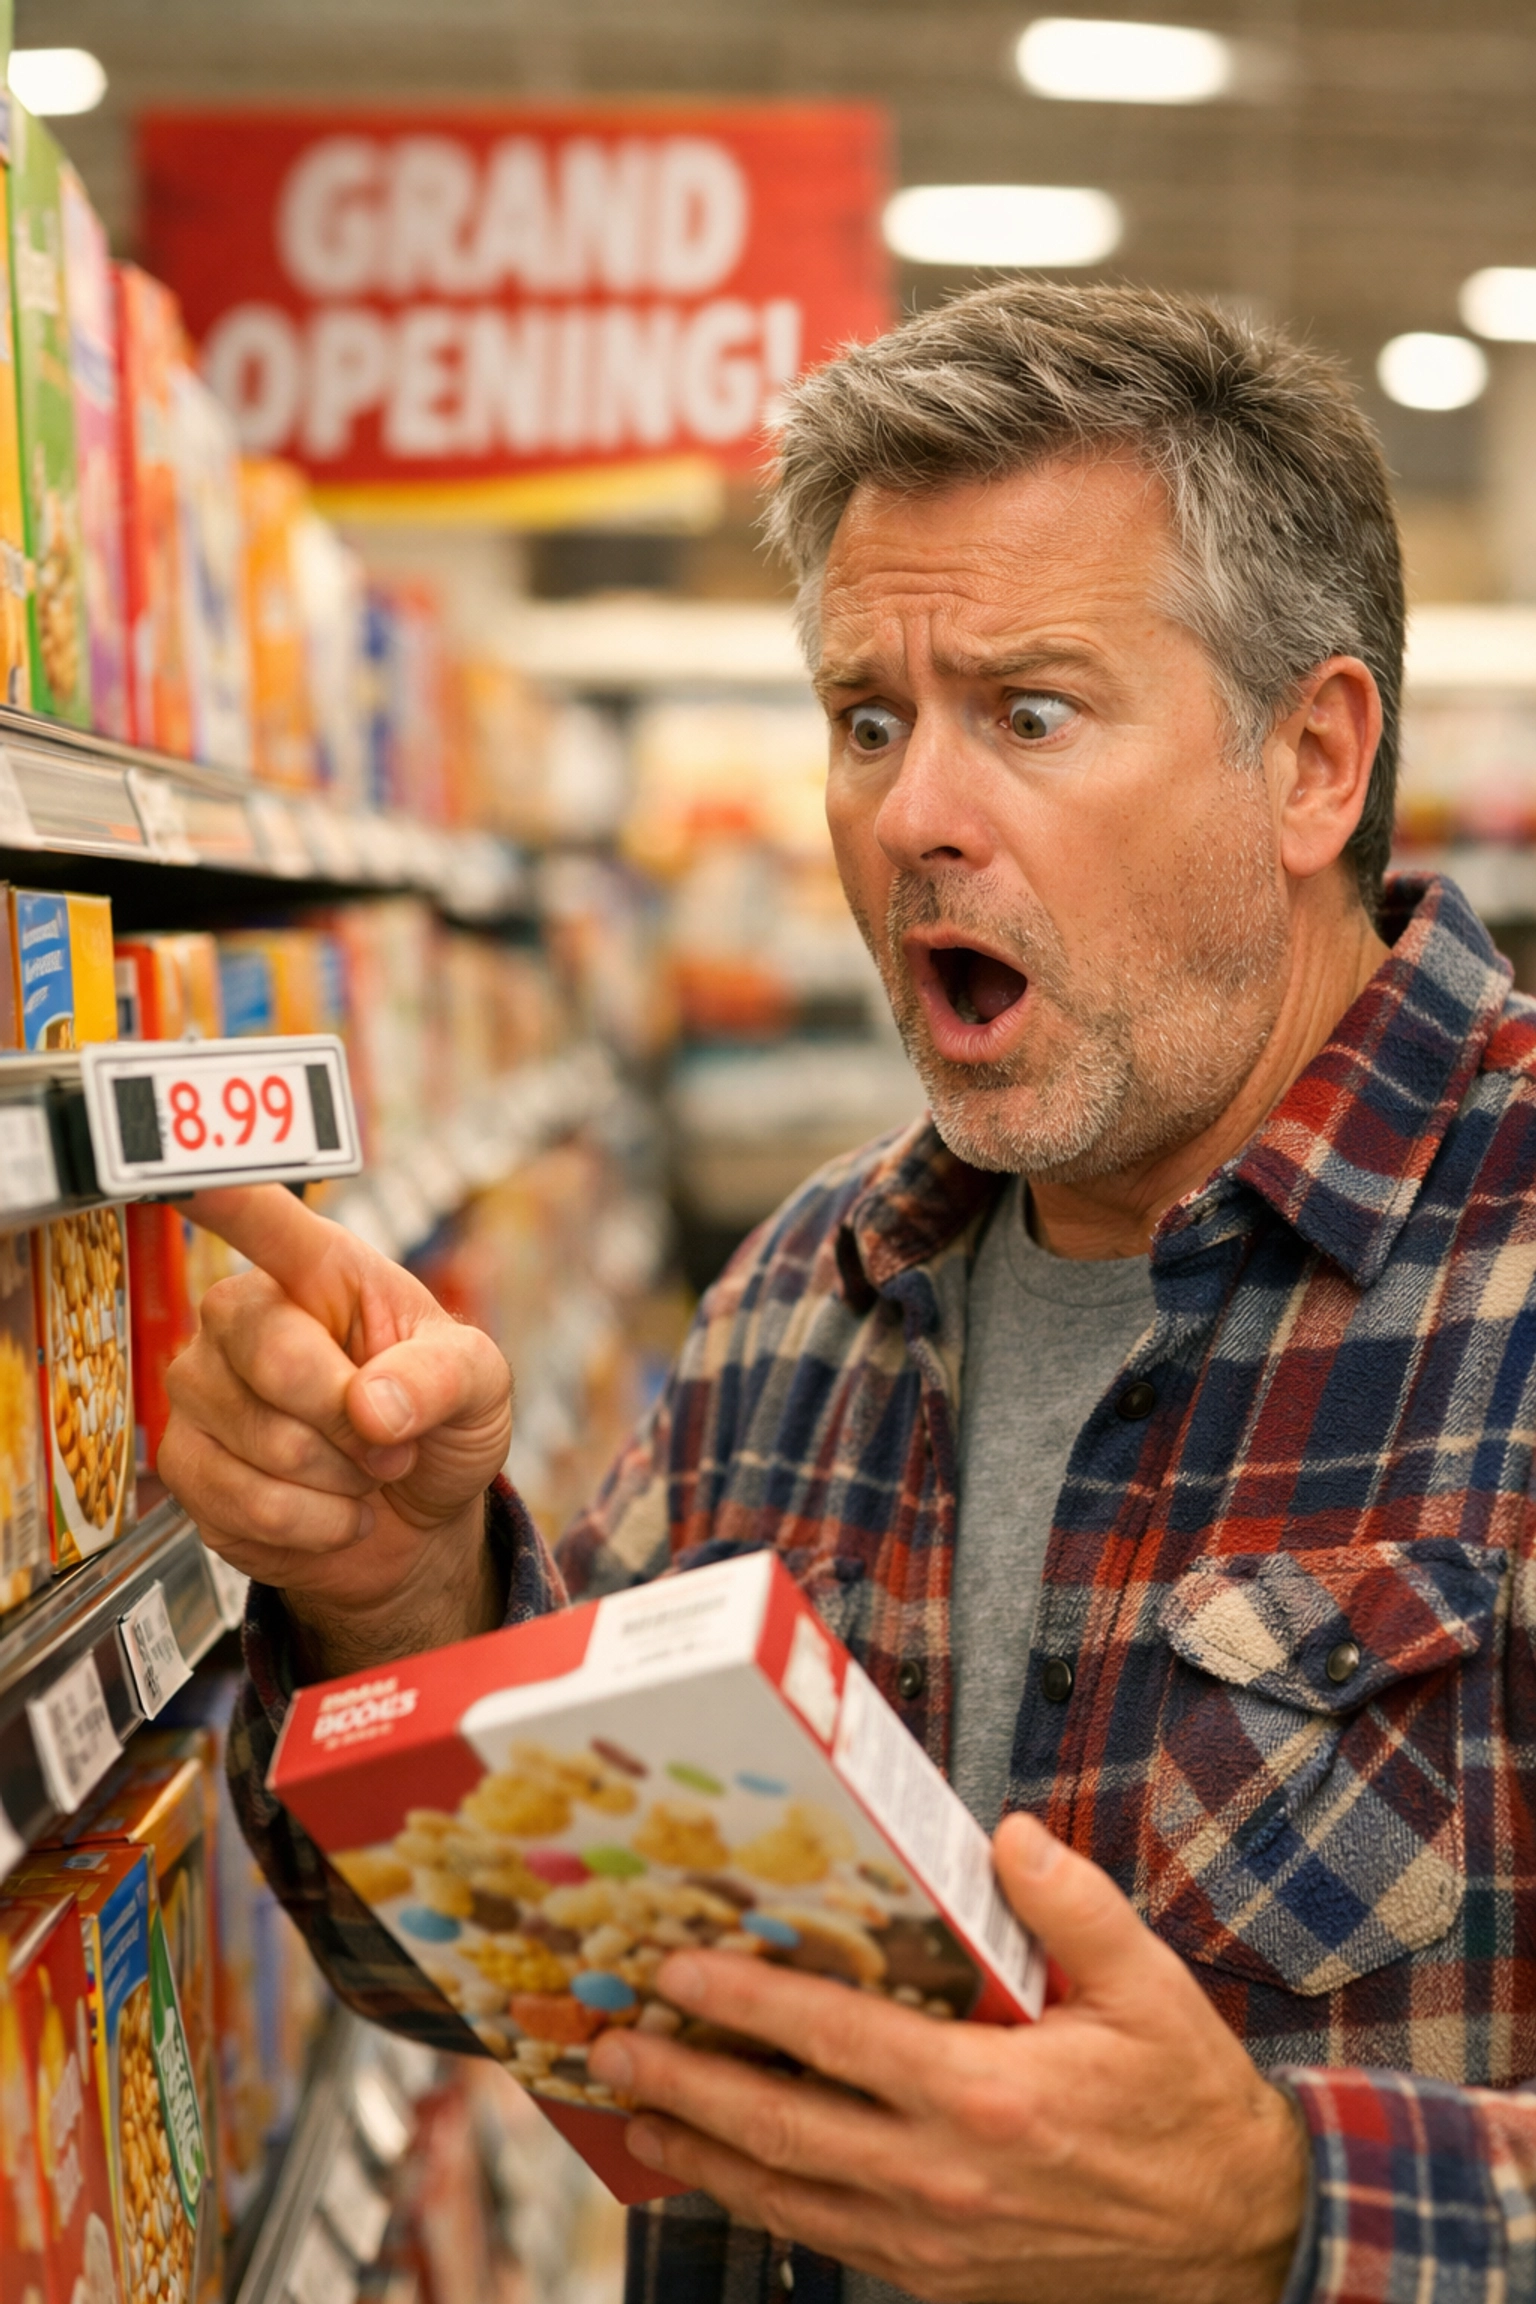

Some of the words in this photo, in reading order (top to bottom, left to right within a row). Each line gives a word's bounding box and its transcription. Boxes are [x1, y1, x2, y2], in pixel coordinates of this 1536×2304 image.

[278, 135, 746, 297] GRAND
[205, 301, 800, 460] OPENING!
[168, 1075, 294, 1151] 8.99
